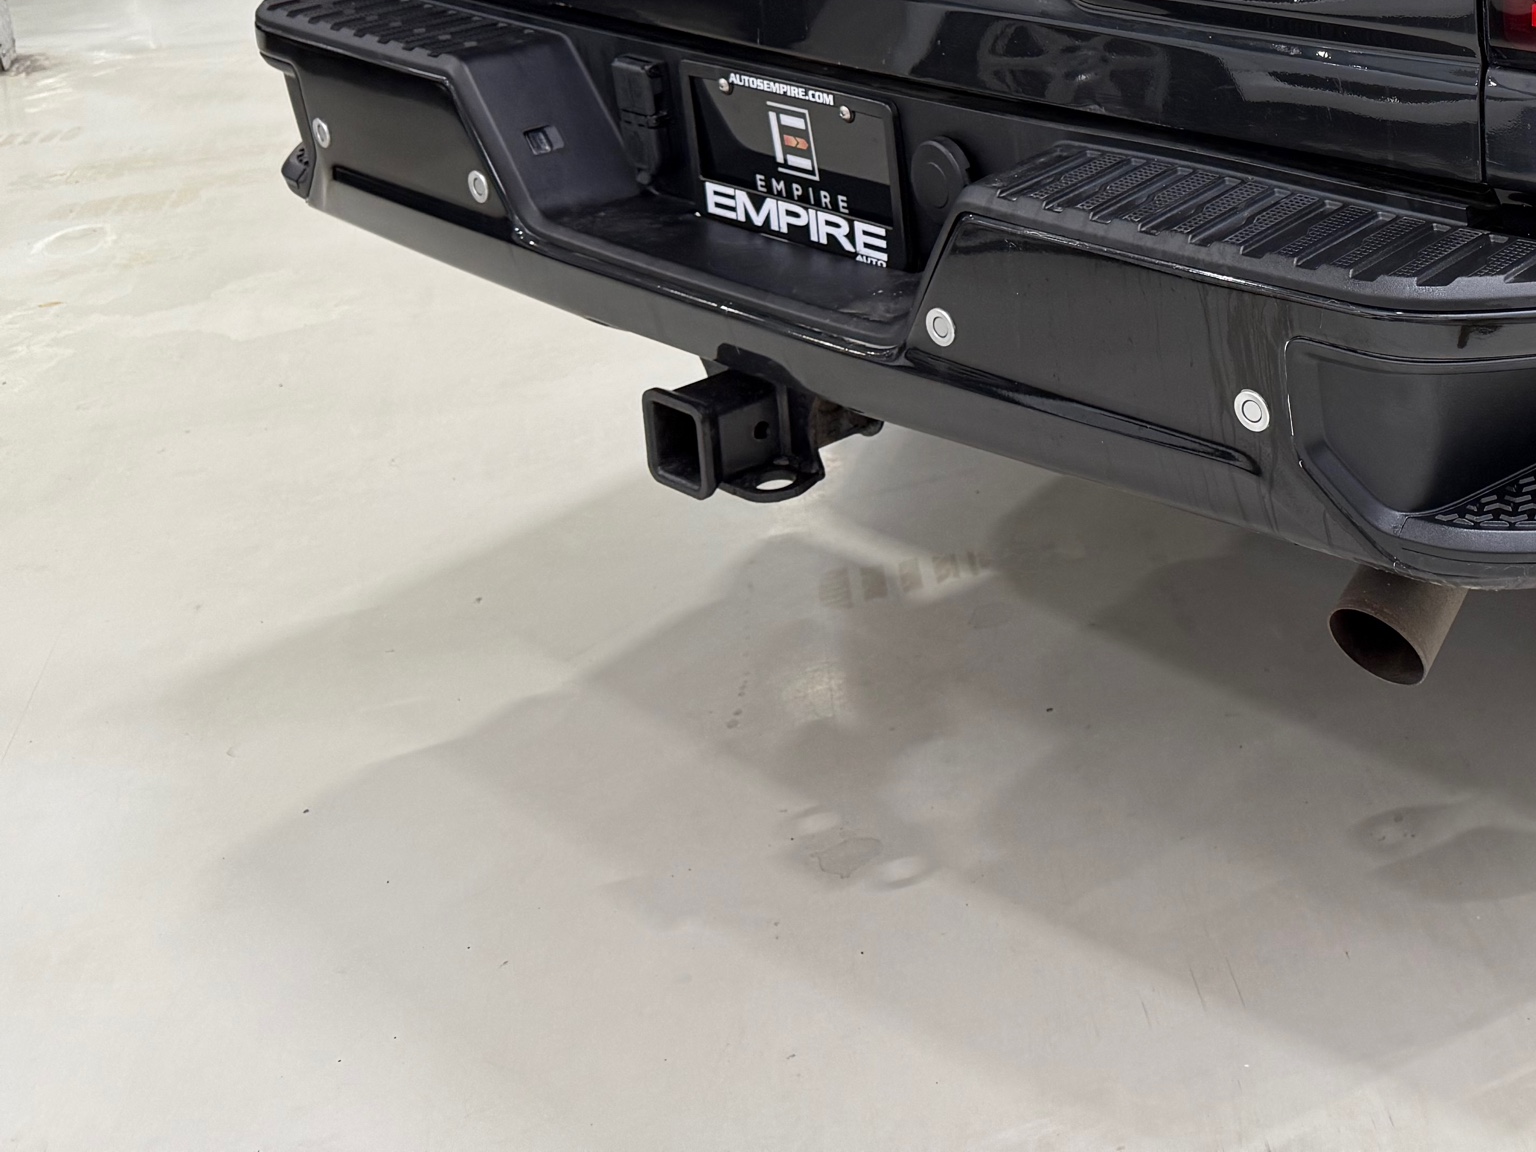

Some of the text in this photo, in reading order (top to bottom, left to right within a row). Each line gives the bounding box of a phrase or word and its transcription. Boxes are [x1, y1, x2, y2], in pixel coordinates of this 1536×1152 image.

[727, 72, 835, 107] AUTOSEMPIRE.COM
[754, 173, 850, 214] EMPIRE
[704, 180, 889, 263] EMPIRE
